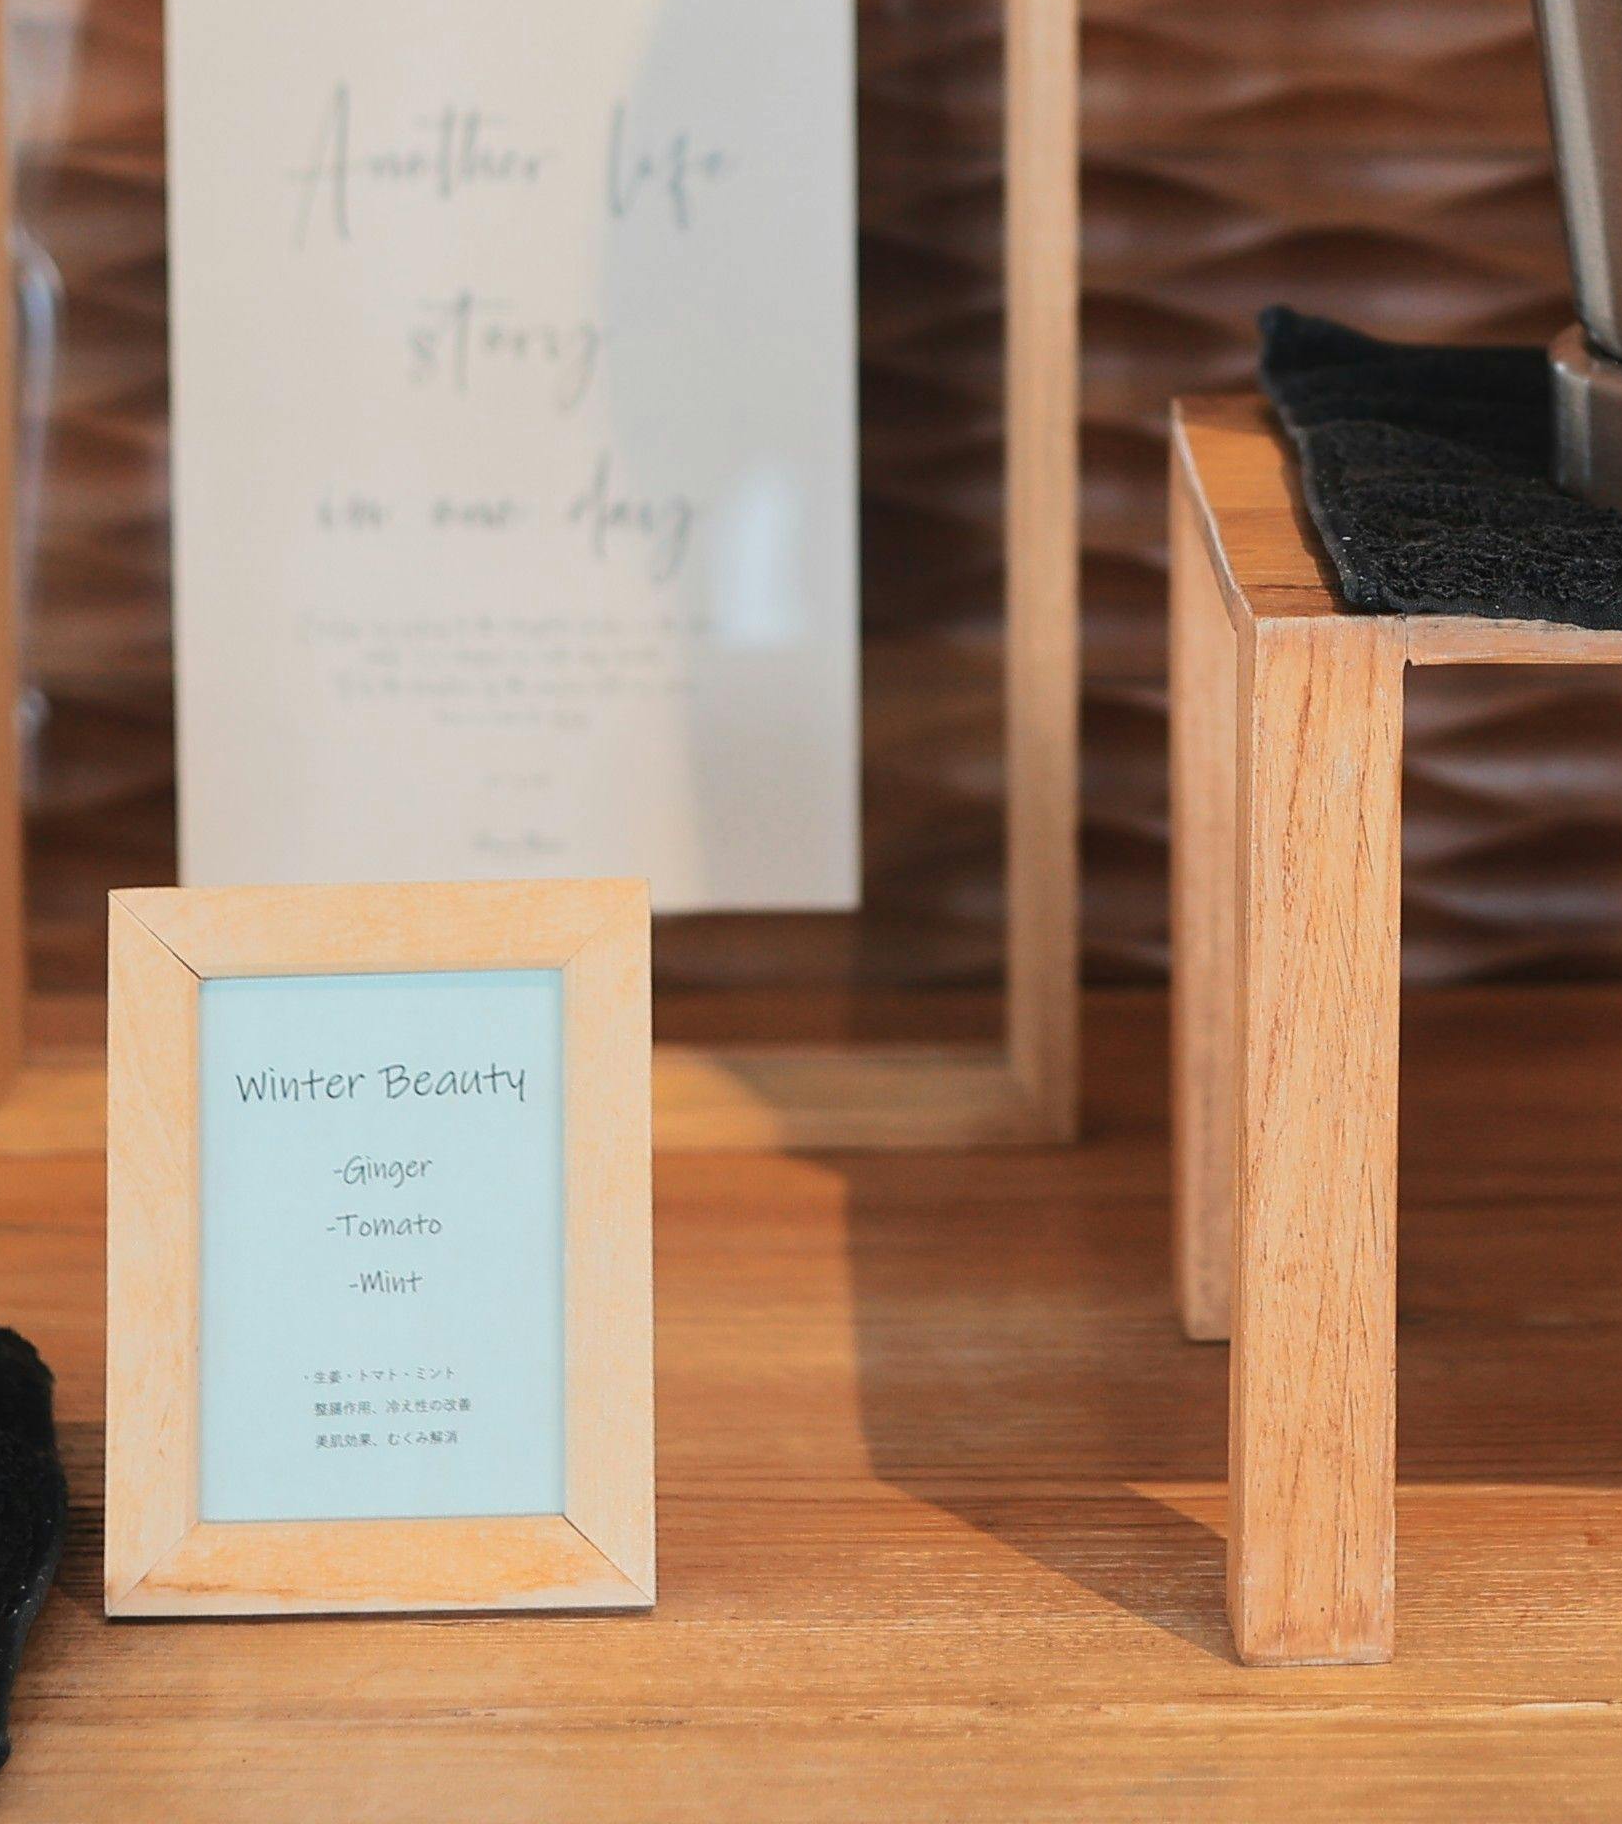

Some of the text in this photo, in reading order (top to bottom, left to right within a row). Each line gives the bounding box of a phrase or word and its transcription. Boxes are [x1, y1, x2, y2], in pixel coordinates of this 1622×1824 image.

[235, 1061, 527, 1103] Winter Beauty
[331, 1154, 434, 1189] -Ginger
[325, 1212, 442, 1237] -Tomato
[348, 1269, 424, 1294] -Mint
